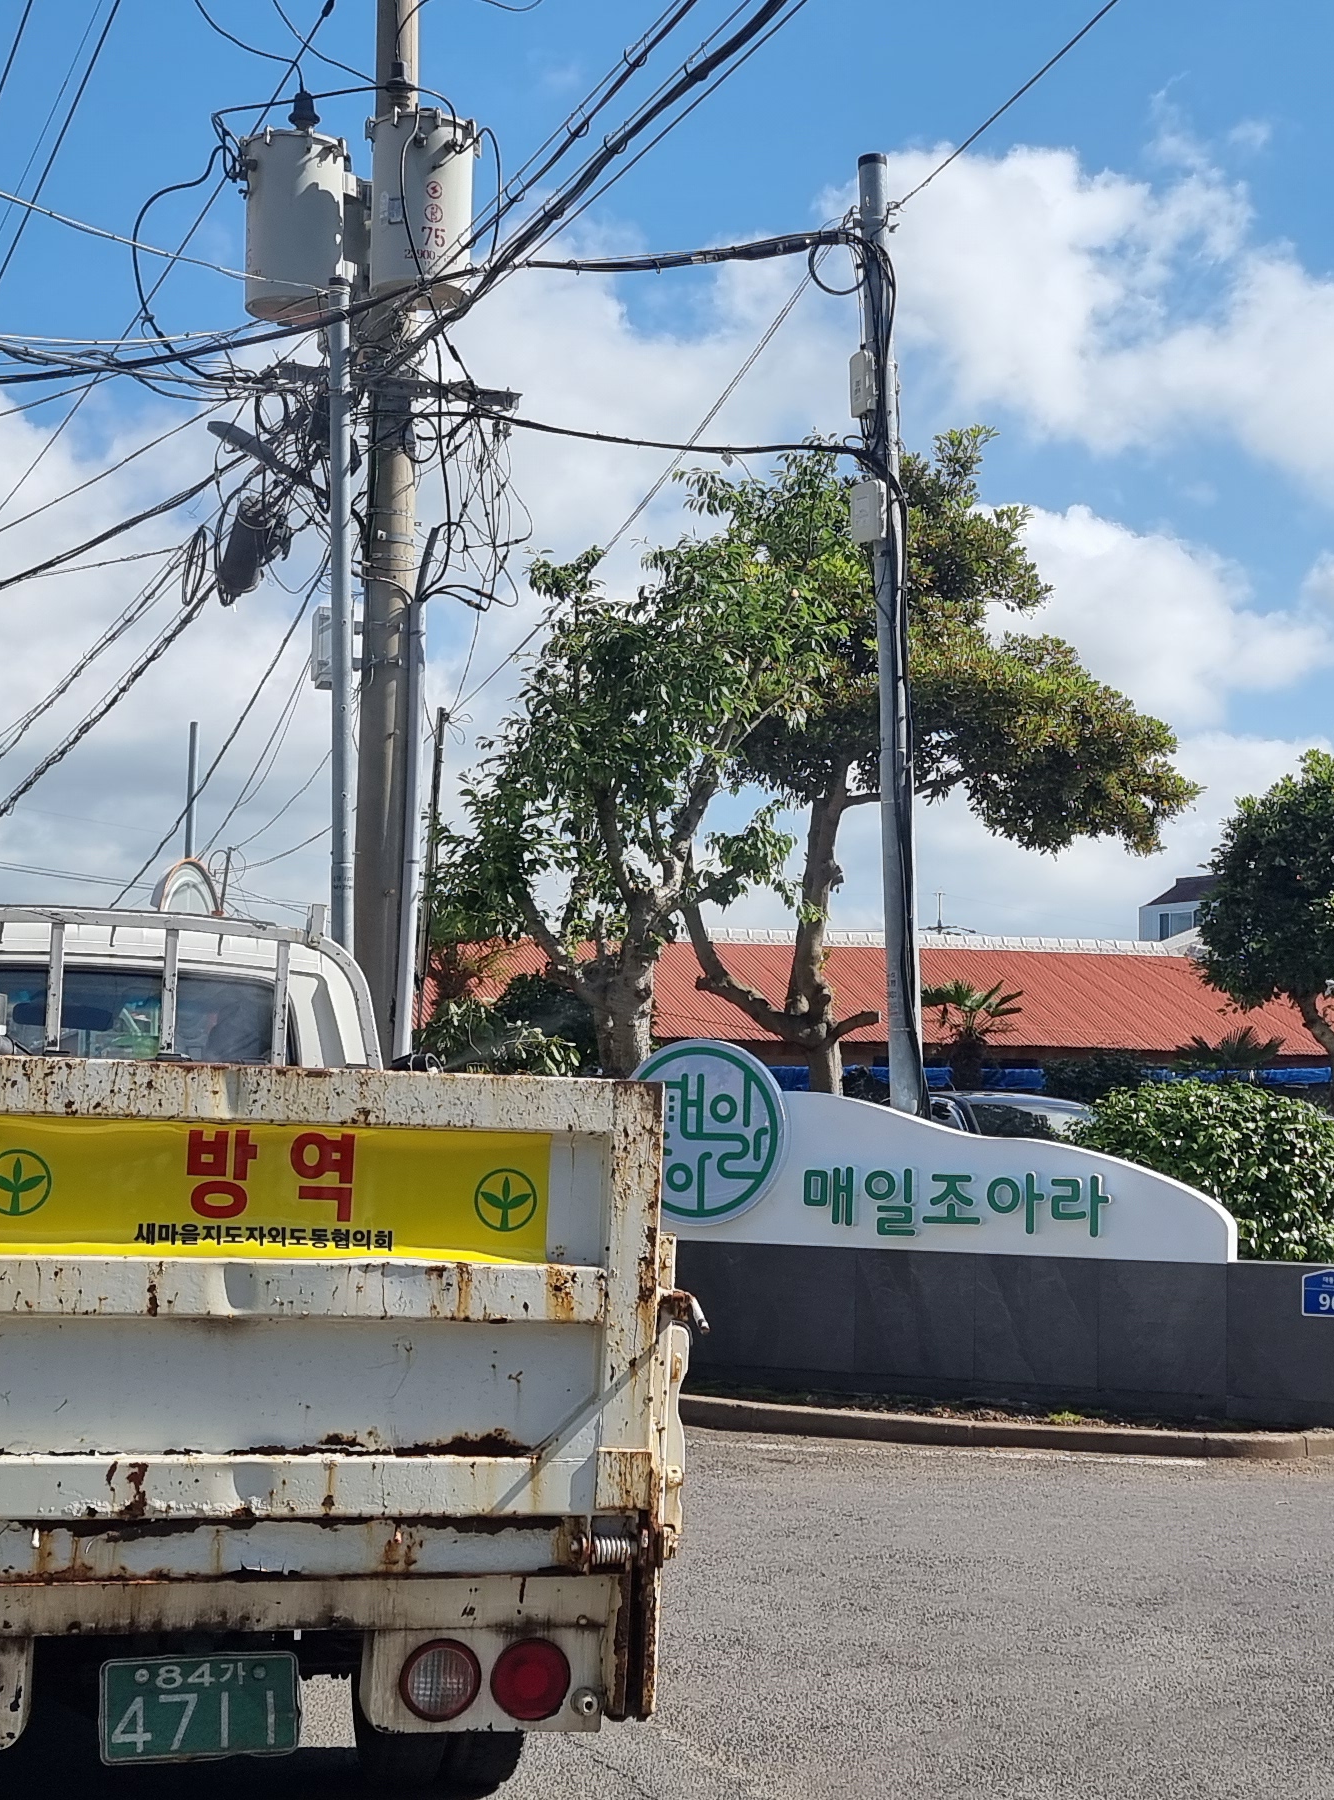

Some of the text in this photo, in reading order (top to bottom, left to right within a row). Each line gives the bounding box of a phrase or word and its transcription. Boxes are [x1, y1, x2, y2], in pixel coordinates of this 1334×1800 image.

[421, 226, 446, 248] 75
[803, 1166, 1112, 1238] 매일조아라
[134, 1223, 394, 1251] 새마을지도자외도동협의회
[155, 1662, 247, 1689] 84가
[111, 1690, 275, 1753] 4711
